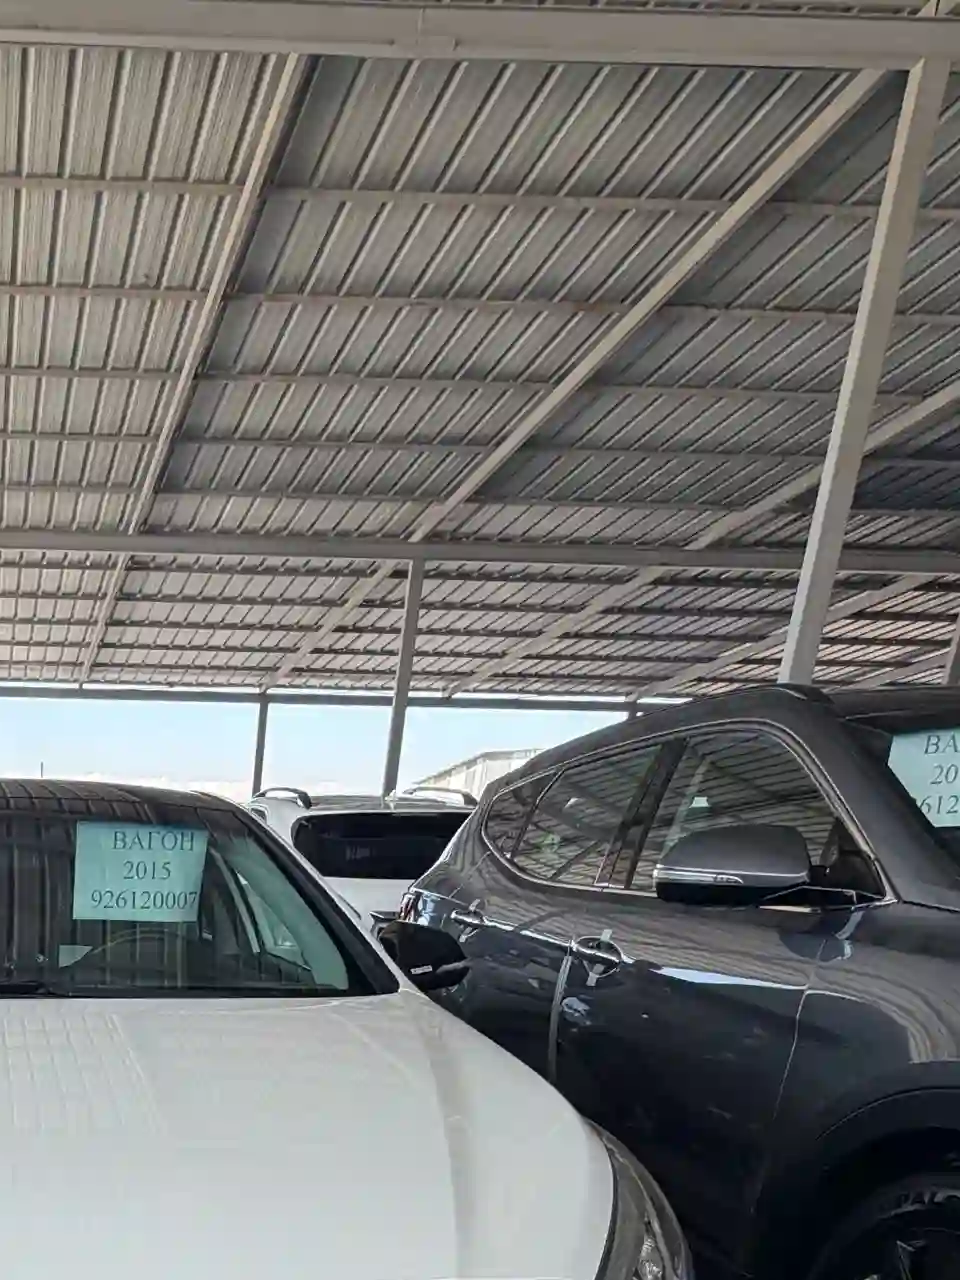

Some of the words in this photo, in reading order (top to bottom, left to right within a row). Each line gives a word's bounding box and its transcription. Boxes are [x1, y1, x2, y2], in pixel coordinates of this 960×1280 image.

[113, 830, 195, 851] ВАГОН
[123, 860, 172, 880] 2015
[90, 888, 198, 910] 926120007
